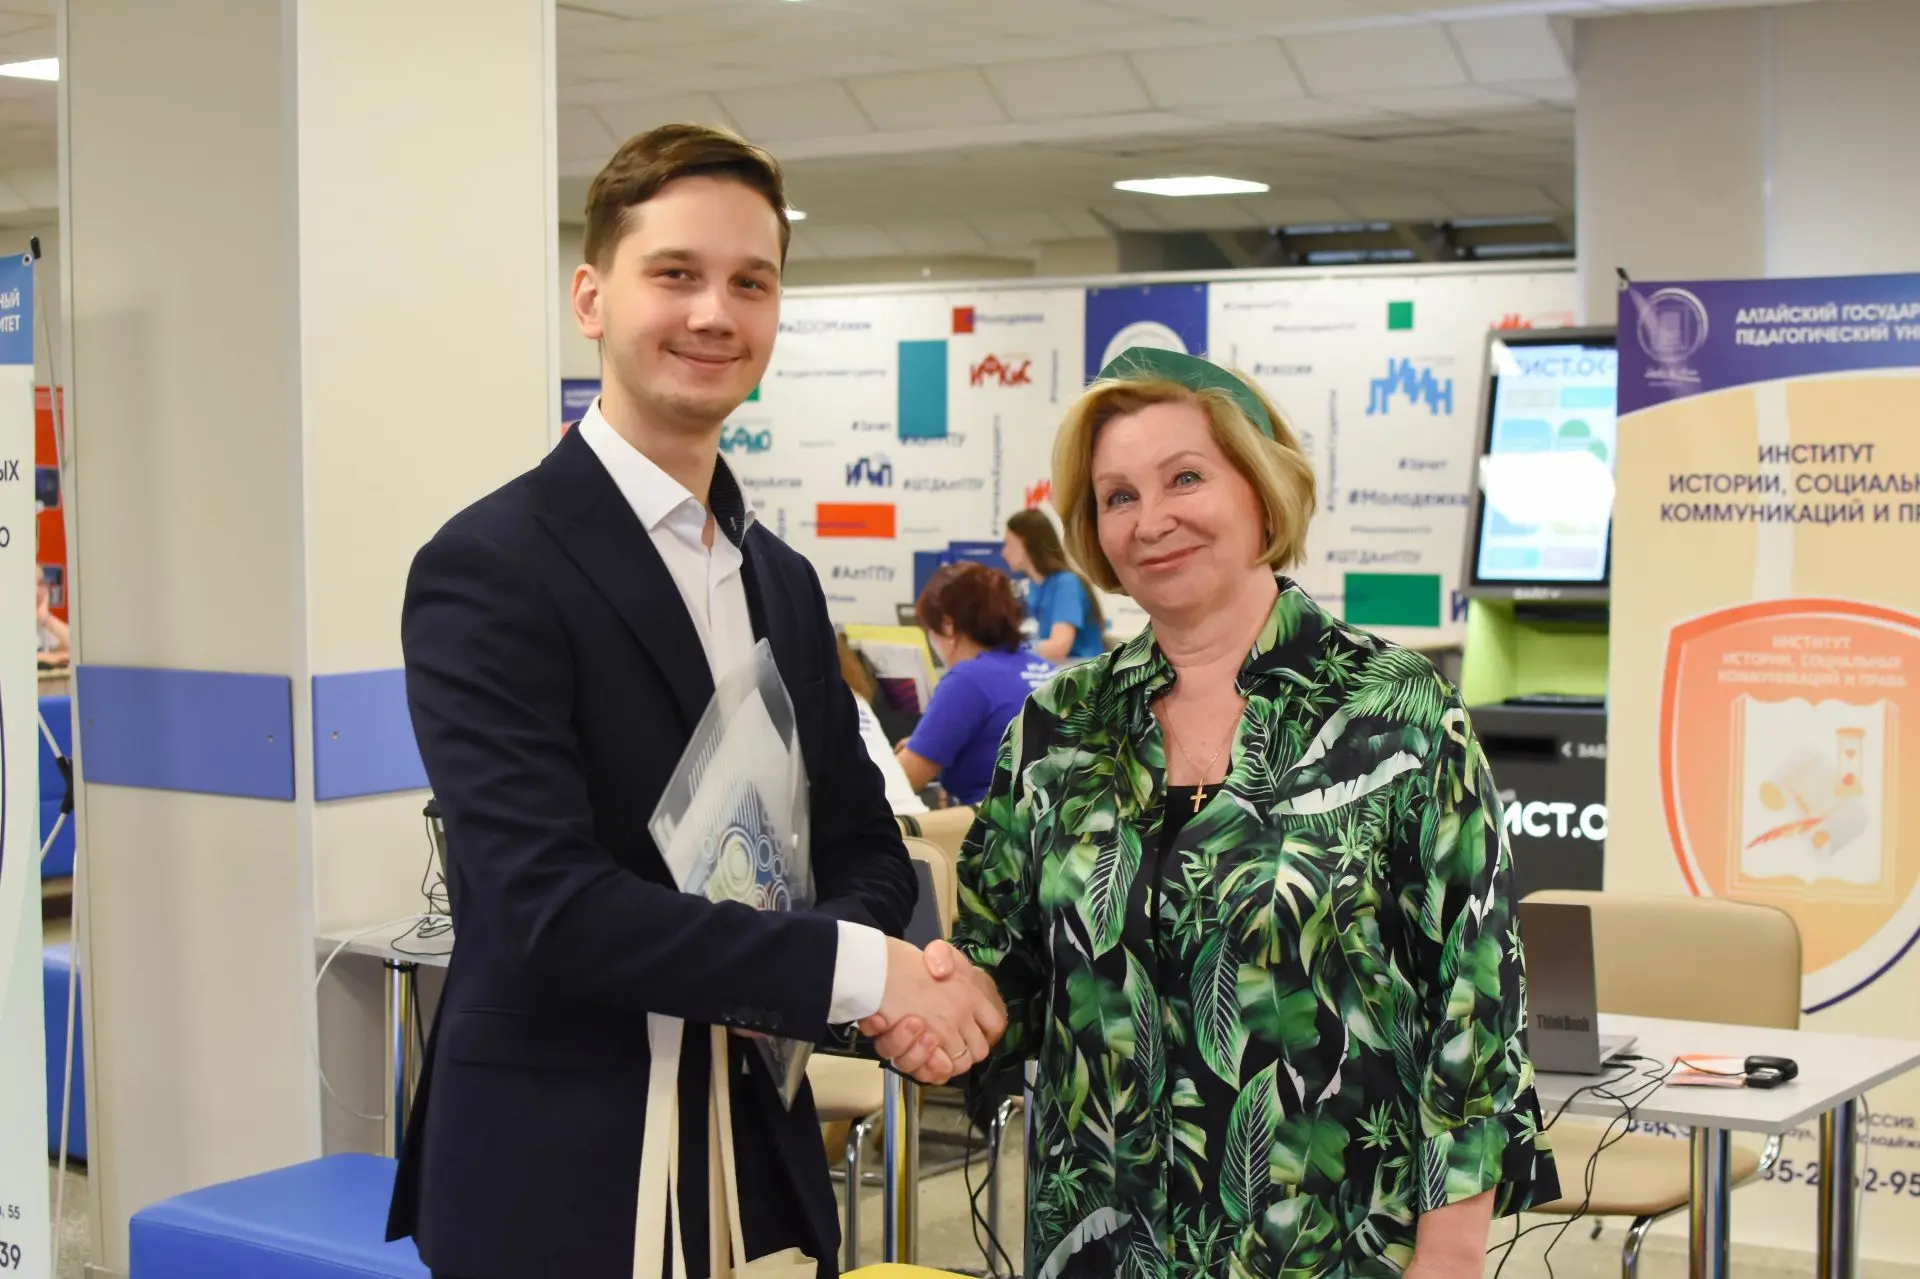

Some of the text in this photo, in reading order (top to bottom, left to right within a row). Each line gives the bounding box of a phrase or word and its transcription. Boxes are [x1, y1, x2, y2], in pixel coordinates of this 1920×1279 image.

[1735, 303, 1837, 324] АЛТАЙСКИЙ
[1735, 323, 1920, 346] ПЕДАГОГИЧЕСКИЙ УН
[1758, 444, 1874, 464] ИНСТИТУТ
[1669, 474, 1787, 495] ИСТОРИИ,
[1661, 498, 1864, 525] КОММУНИКАЦИЙ
[1874, 504, 1889, 523] И
[1536, 1014, 1590, 1032] ThinkBook
